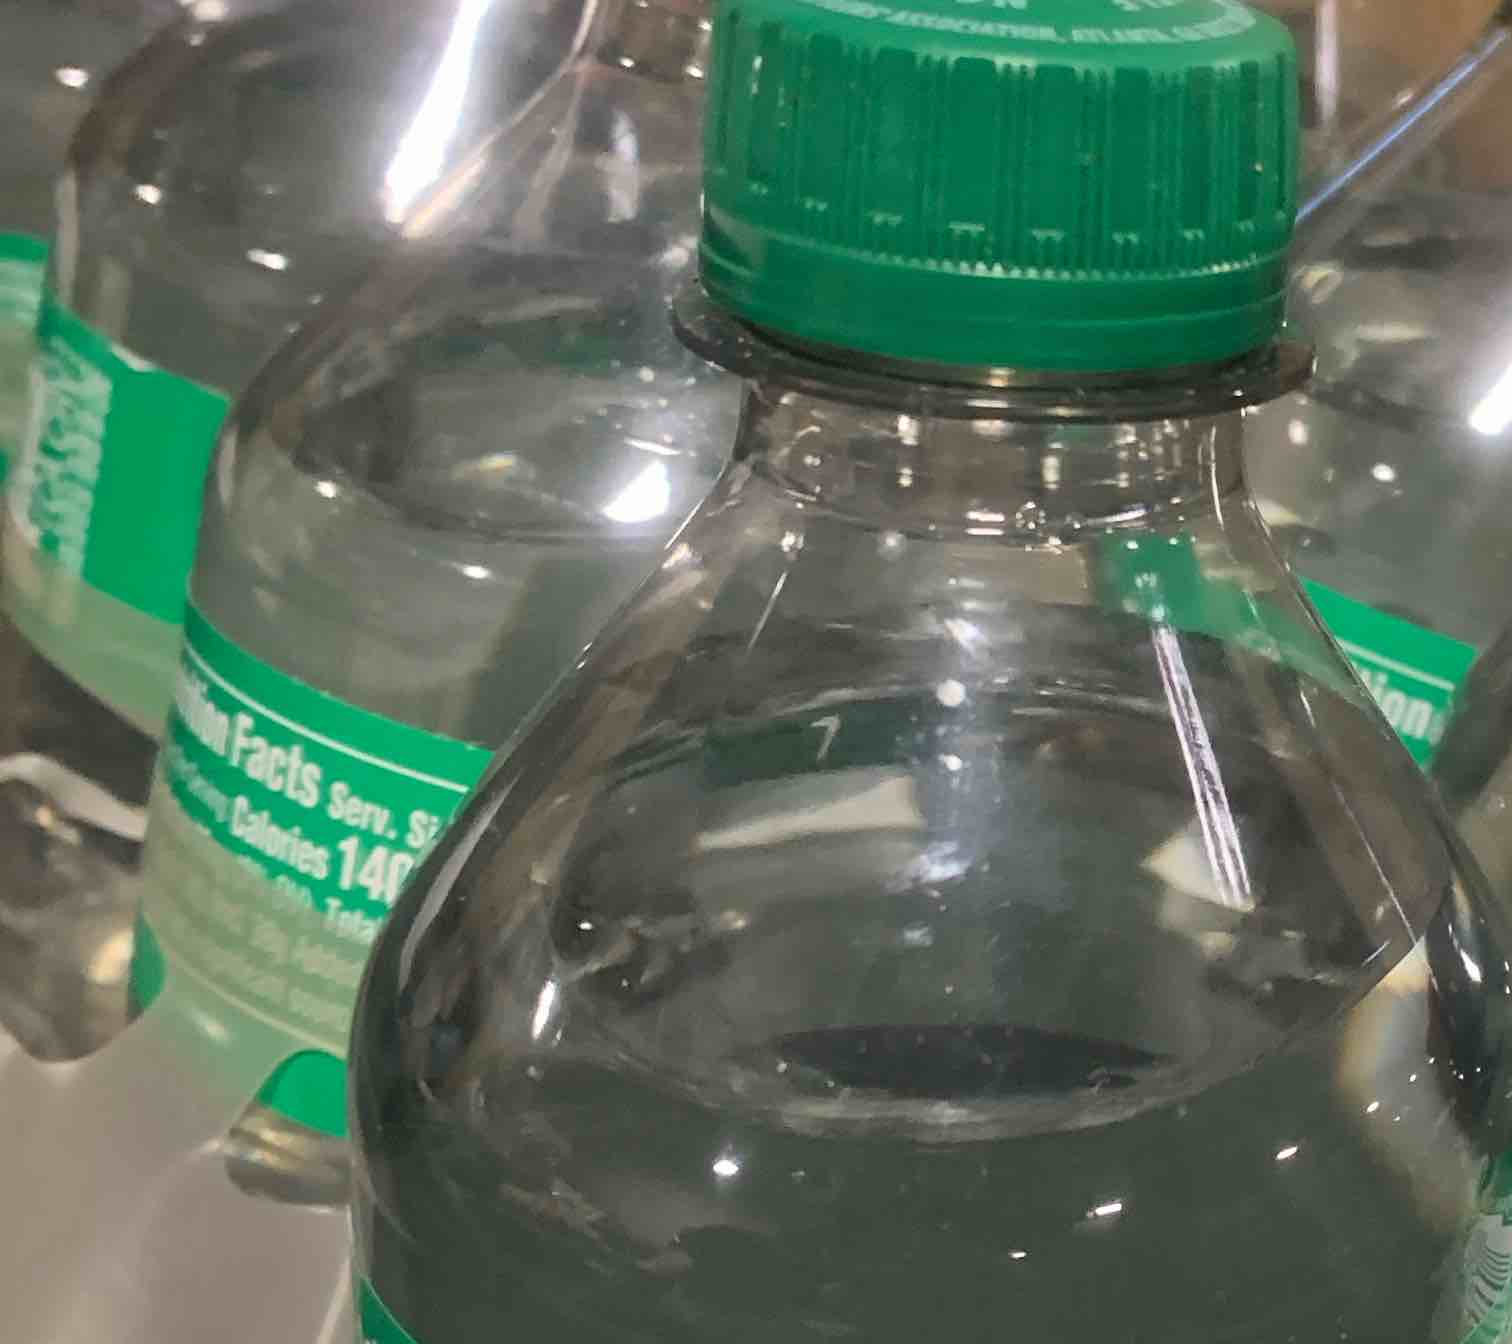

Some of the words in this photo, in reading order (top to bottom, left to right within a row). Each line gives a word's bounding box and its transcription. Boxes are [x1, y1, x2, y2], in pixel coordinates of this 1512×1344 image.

[229, 711, 322, 808] Facts
[326, 781, 398, 841] Serv.
[229, 794, 330, 880] Calories
